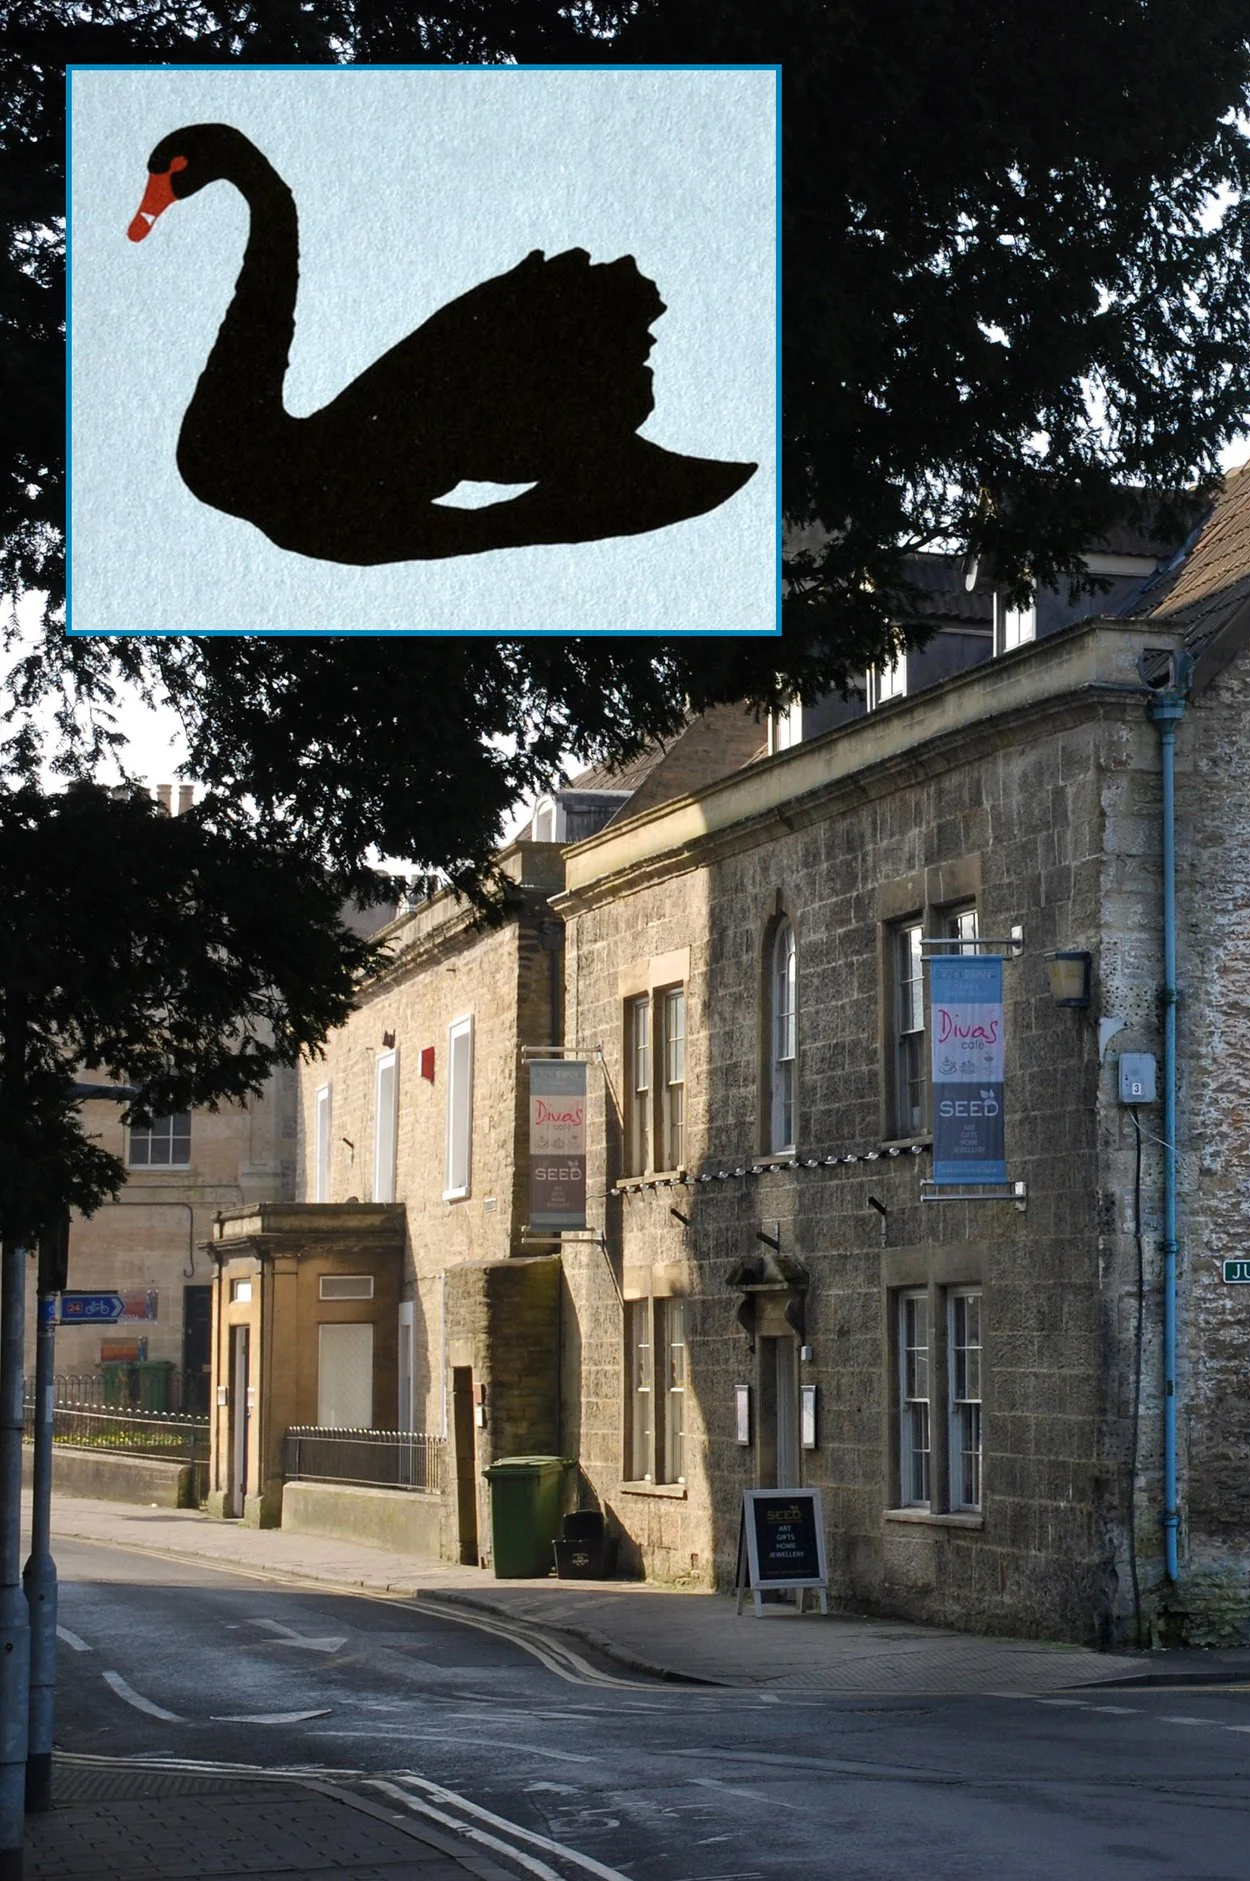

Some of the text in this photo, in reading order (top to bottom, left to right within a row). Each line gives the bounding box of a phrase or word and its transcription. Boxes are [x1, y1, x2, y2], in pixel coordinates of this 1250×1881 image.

[938, 1009, 998, 1043] Divas
[535, 1099, 583, 1126] Divas
[940, 1100, 999, 1117] SEED
[535, 1167, 583, 1181] SEED
[69, 1303, 80, 1312] 24
[766, 1510, 802, 1520] SEED
[776, 1533, 795, 1541] GIFTS
